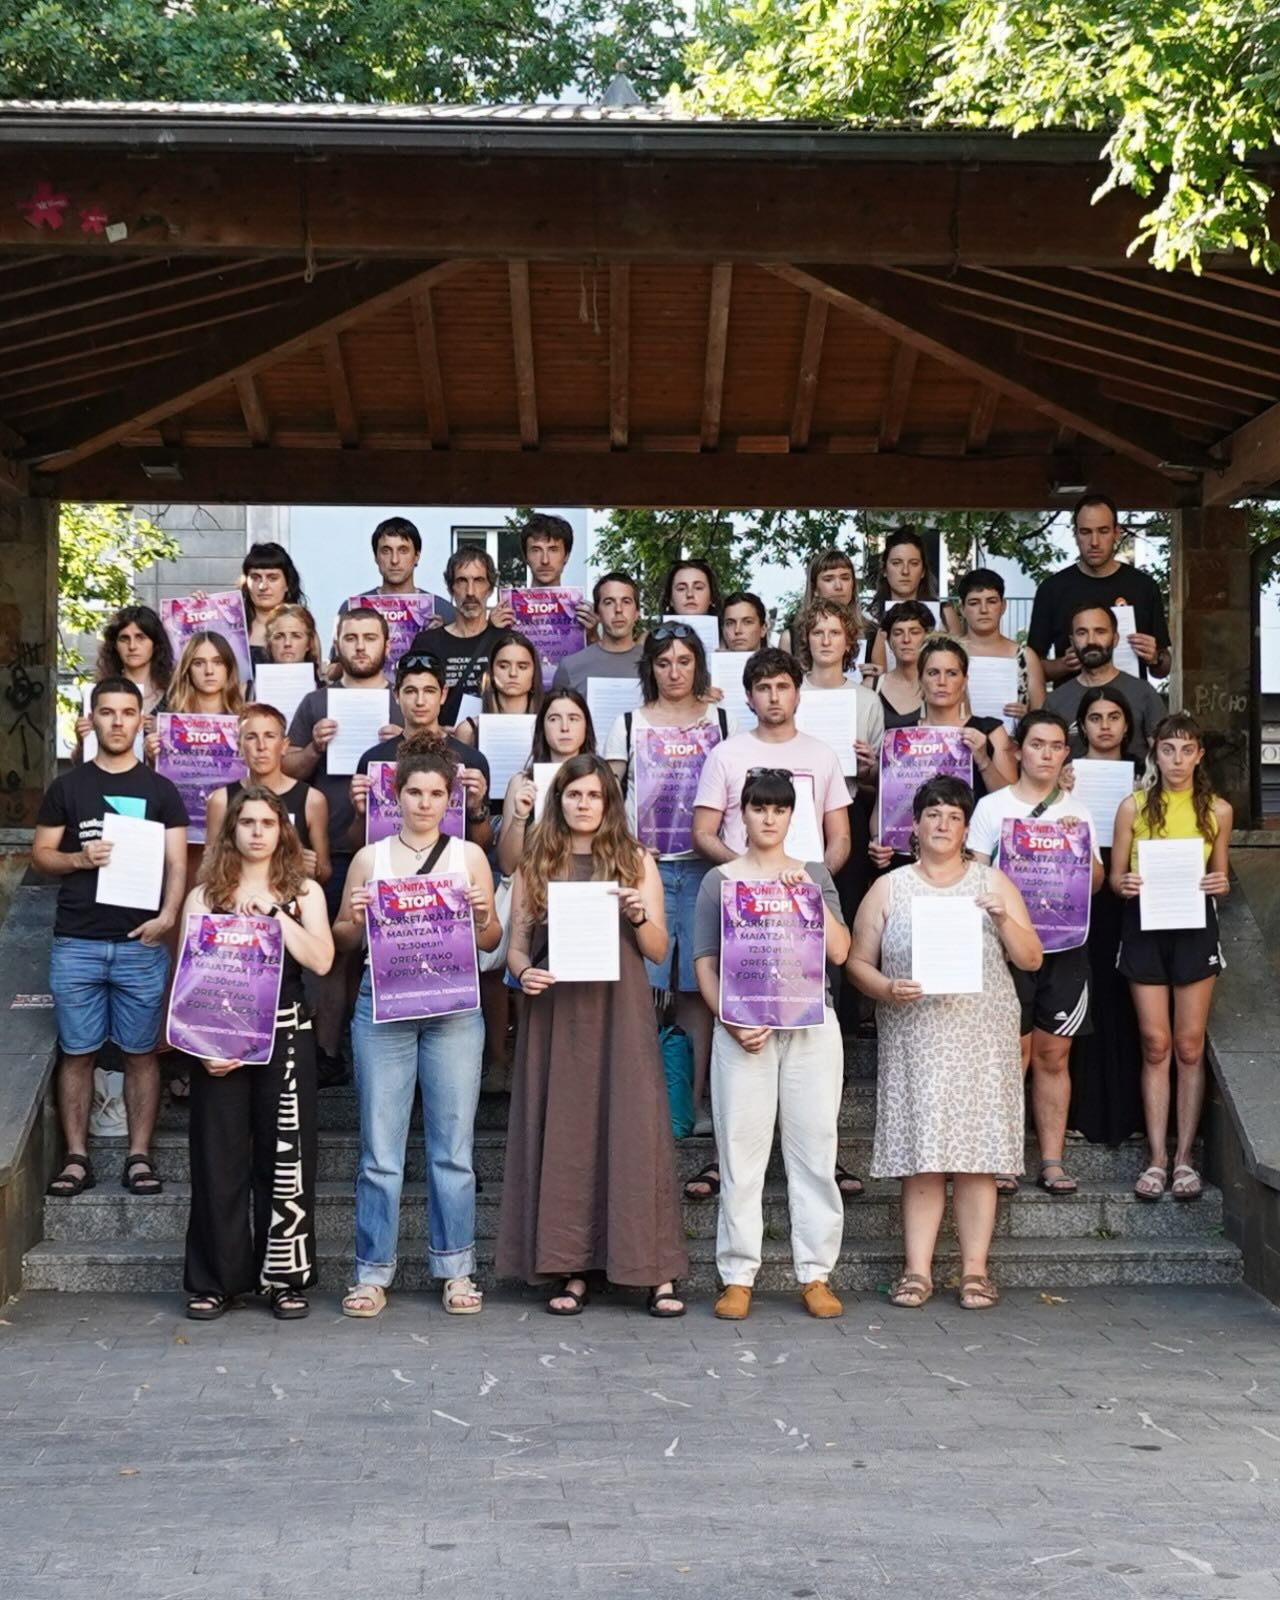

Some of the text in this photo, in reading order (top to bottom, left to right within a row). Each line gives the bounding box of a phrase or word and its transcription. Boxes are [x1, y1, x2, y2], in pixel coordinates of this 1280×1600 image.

[527, 603, 558, 613] STOP!
[186, 609, 218, 623] STOP!
[383, 610, 408, 621] TOP!
[186, 732, 221, 744] STOP!
[663, 744, 697, 755] STOP!
[909, 743, 943, 754] STOP!
[1028, 837, 1065, 849] STOP!
[397, 893, 439, 910] STOP!
[754, 899, 793, 914] STOP!
[386, 925, 439, 939] MAIATZAK
[213, 932, 253, 945] STOP!
